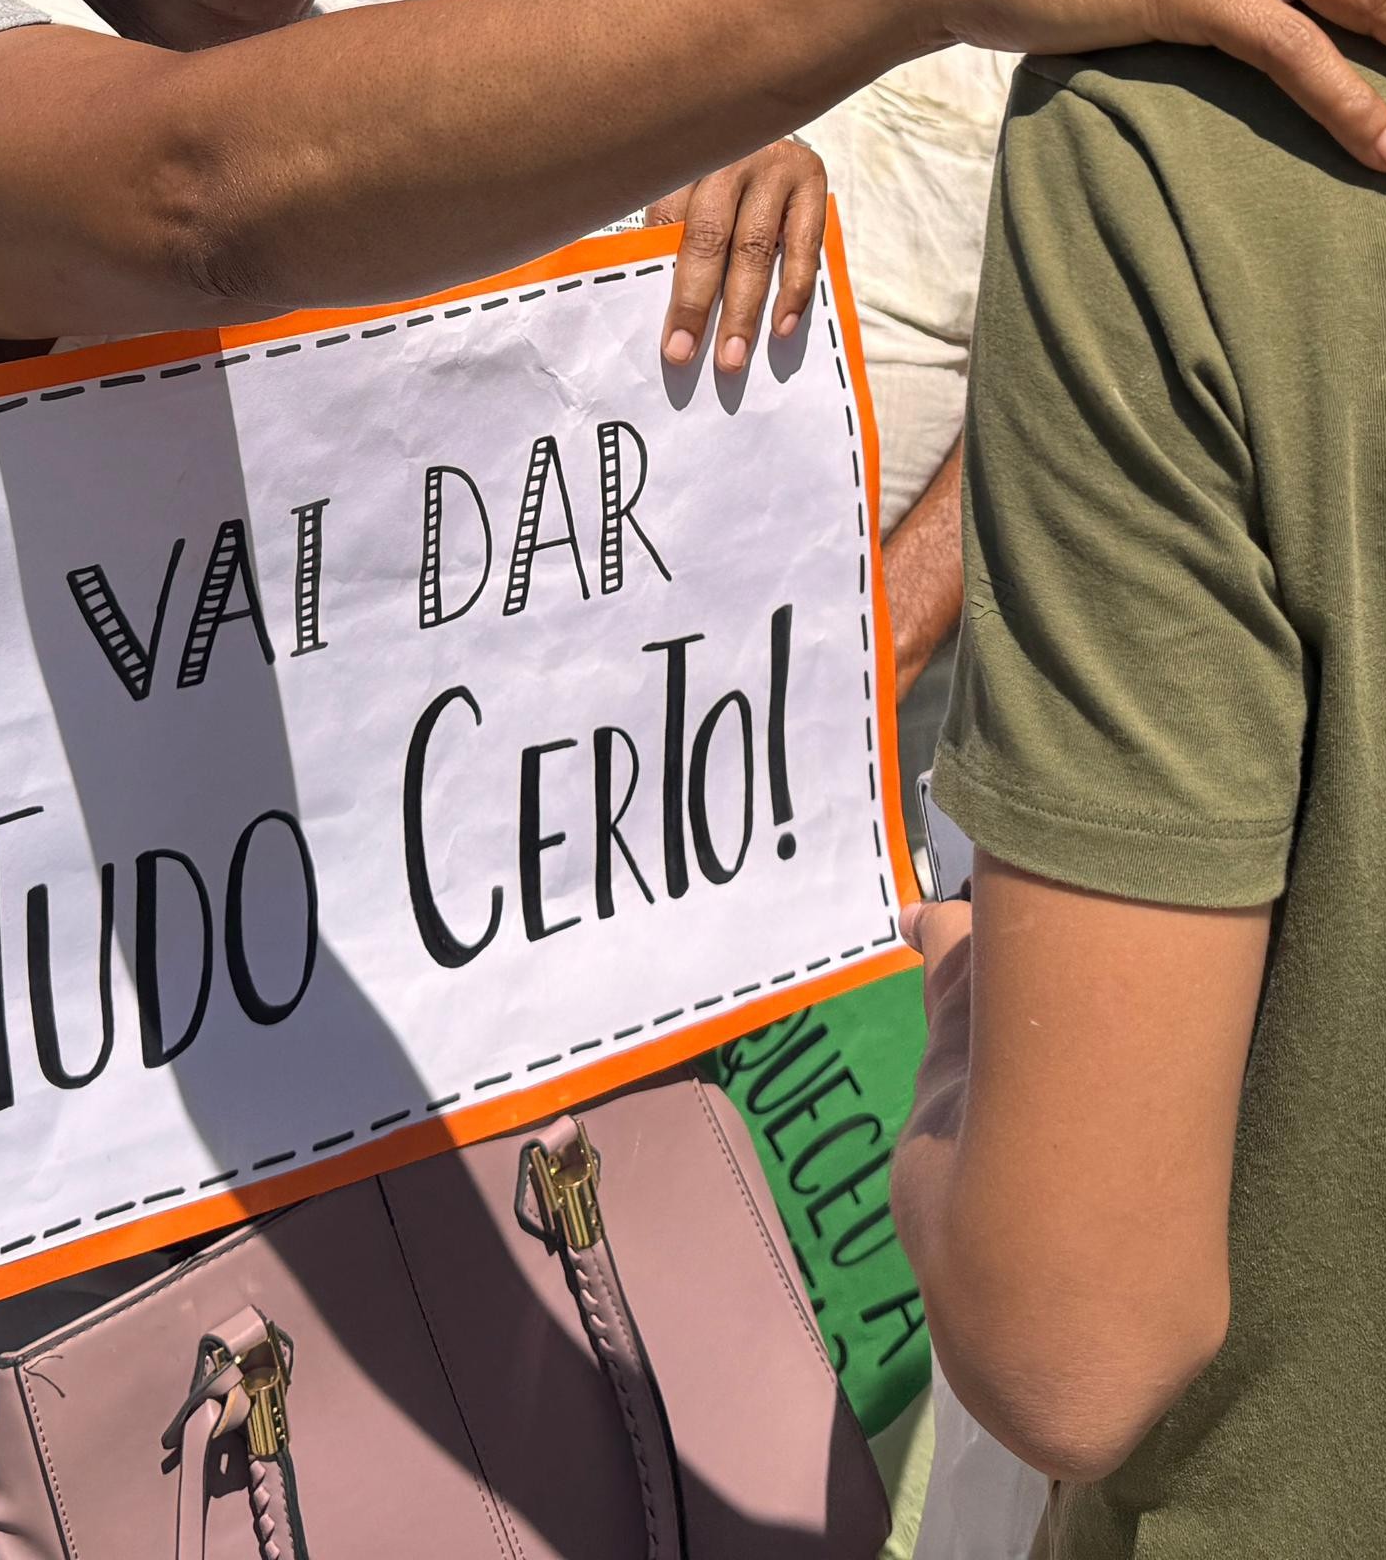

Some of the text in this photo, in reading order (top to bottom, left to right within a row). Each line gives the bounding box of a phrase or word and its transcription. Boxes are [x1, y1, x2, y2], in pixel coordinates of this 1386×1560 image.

[66, 420, 673, 701] VAI DAR
[404, 602, 795, 970] CERTO!
